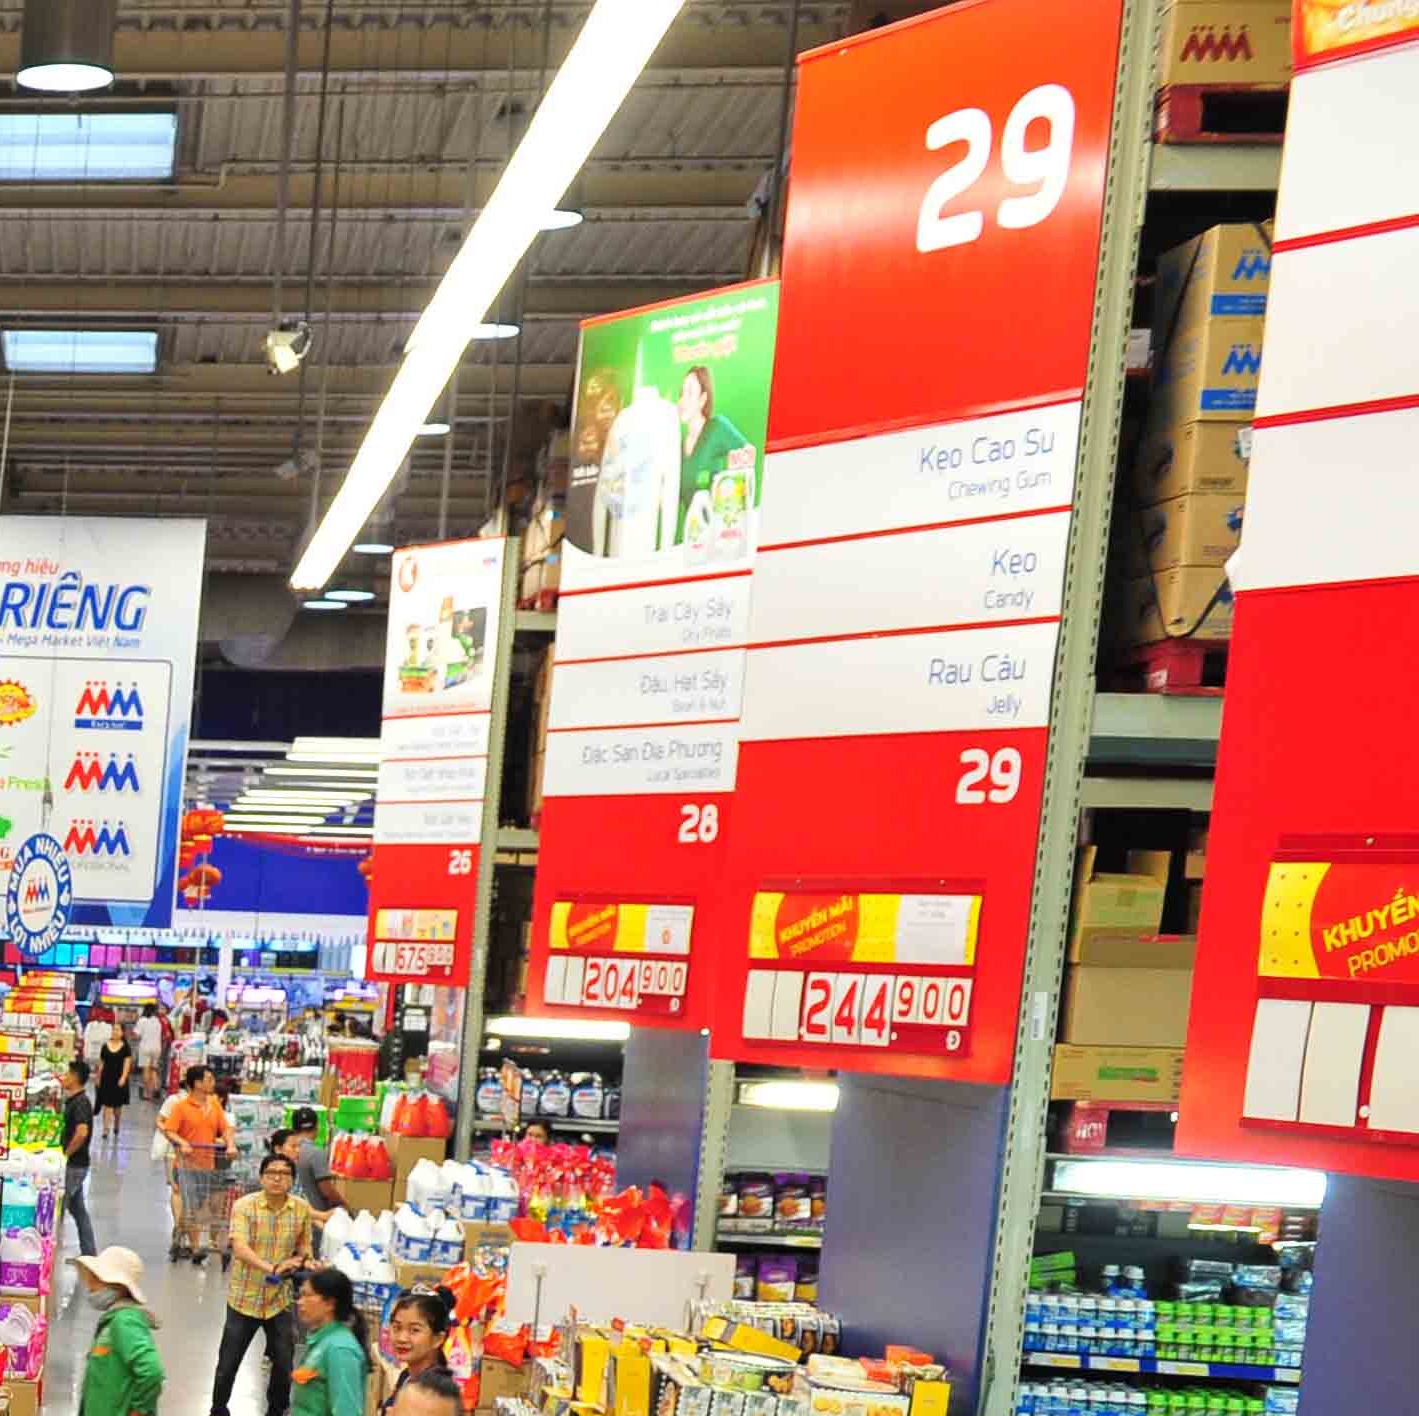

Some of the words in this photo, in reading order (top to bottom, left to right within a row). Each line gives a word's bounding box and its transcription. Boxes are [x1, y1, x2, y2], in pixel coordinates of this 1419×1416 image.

[915, 82, 1075, 255] 29
[920, 440, 962, 475] Kẹo
[971, 439, 1017, 464] Cao
[1025, 429, 1055, 457] Su
[948, 474, 1012, 503] Chewing
[1016, 469, 1052, 494] Gum
[991, 549, 1037, 583] Kẹo
[983, 586, 1035, 613] Candy
[927, 656, 973, 687] Rau
[955, 747, 1022, 805] 29
[679, 804, 718, 844] 28
[449, 849, 473, 875] 26
